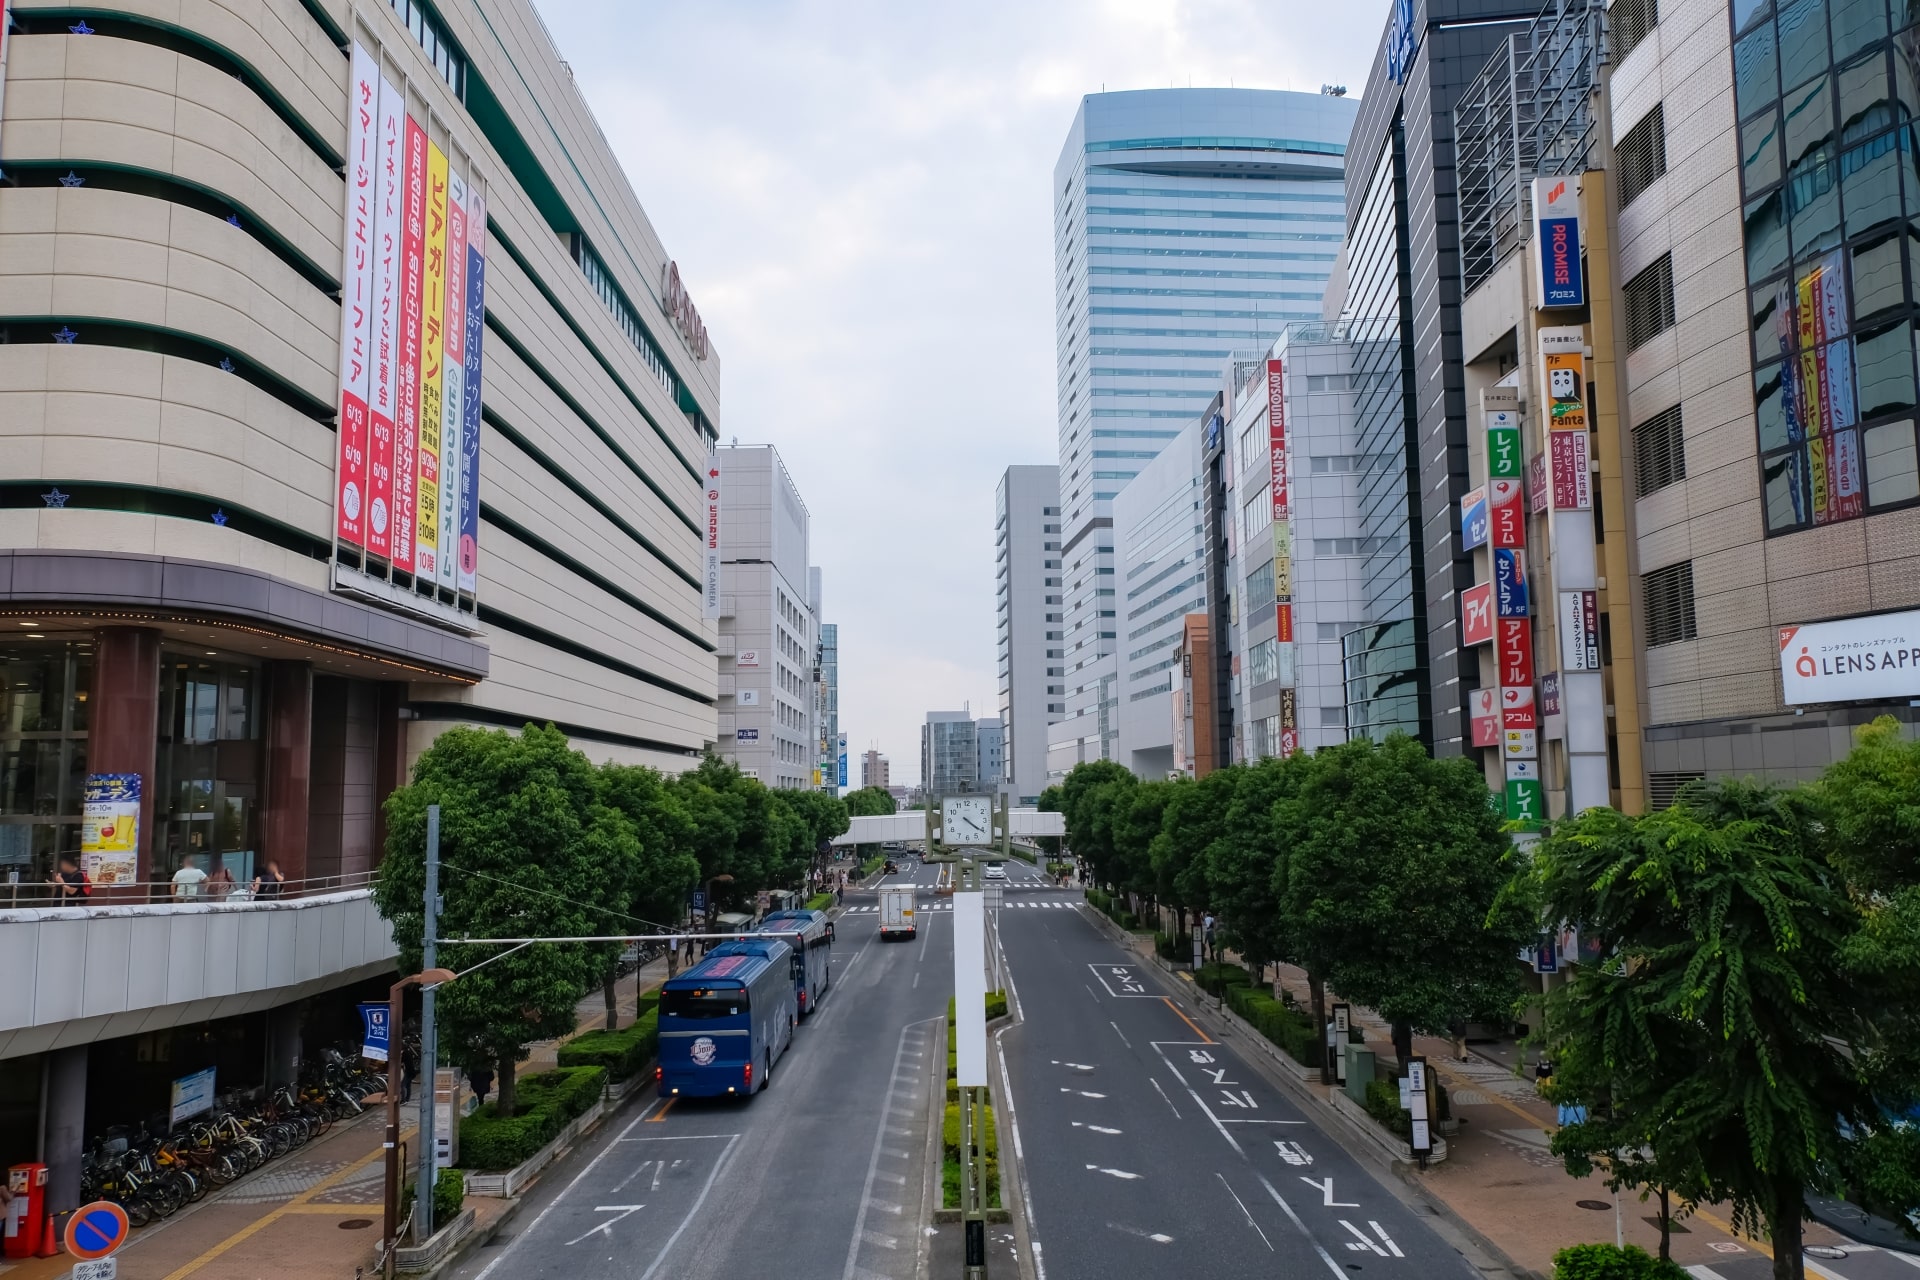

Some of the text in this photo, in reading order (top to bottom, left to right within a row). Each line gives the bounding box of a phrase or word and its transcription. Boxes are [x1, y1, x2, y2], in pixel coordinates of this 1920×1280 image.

[387, 114, 396, 217] ハイネット
[351, 79, 371, 382] サマージュエリーフェア
[1552, 225, 1569, 284] PROMISE
[427, 173, 445, 378] ビアガーデン
[1550, 290, 1575, 299] プロミス
[1547, 356, 1560, 364] 7F
[347, 403, 362, 425] 6/13
[1270, 371, 1282, 427] JOYSOUND
[374, 423, 389, 443] 6/13
[1551, 415, 1584, 426] Fanta
[345, 444, 361, 467] 6/19
[1497, 432, 1512, 473] レイク
[1553, 437, 1563, 481] クリニック
[1563, 436, 1574, 505] 東京ビューティー
[373, 463, 388, 483] 6/19
[1272, 448, 1286, 497] カラオケ
[1578, 474, 1588, 505] 女性専門
[709, 505, 717, 549] ビックカメラ
[1275, 504, 1287, 513] 6F
[1501, 509, 1515, 544] アコム
[418, 551, 434, 573] 10階
[1498, 558, 1512, 615] セントラル
[1506, 621, 1525, 683] アイフル
[1573, 617, 1583, 669] スキンクリニック
[1781, 631, 1791, 640] 3F
[1821, 636, 1905, 652] コンタクトのレンズアップル
[1283, 690, 1294, 729] 山内農場
[1505, 714, 1532, 722] アコム
[691, 1044, 716, 1056] Lions
[1274, 1141, 1405, 1257] バス停
